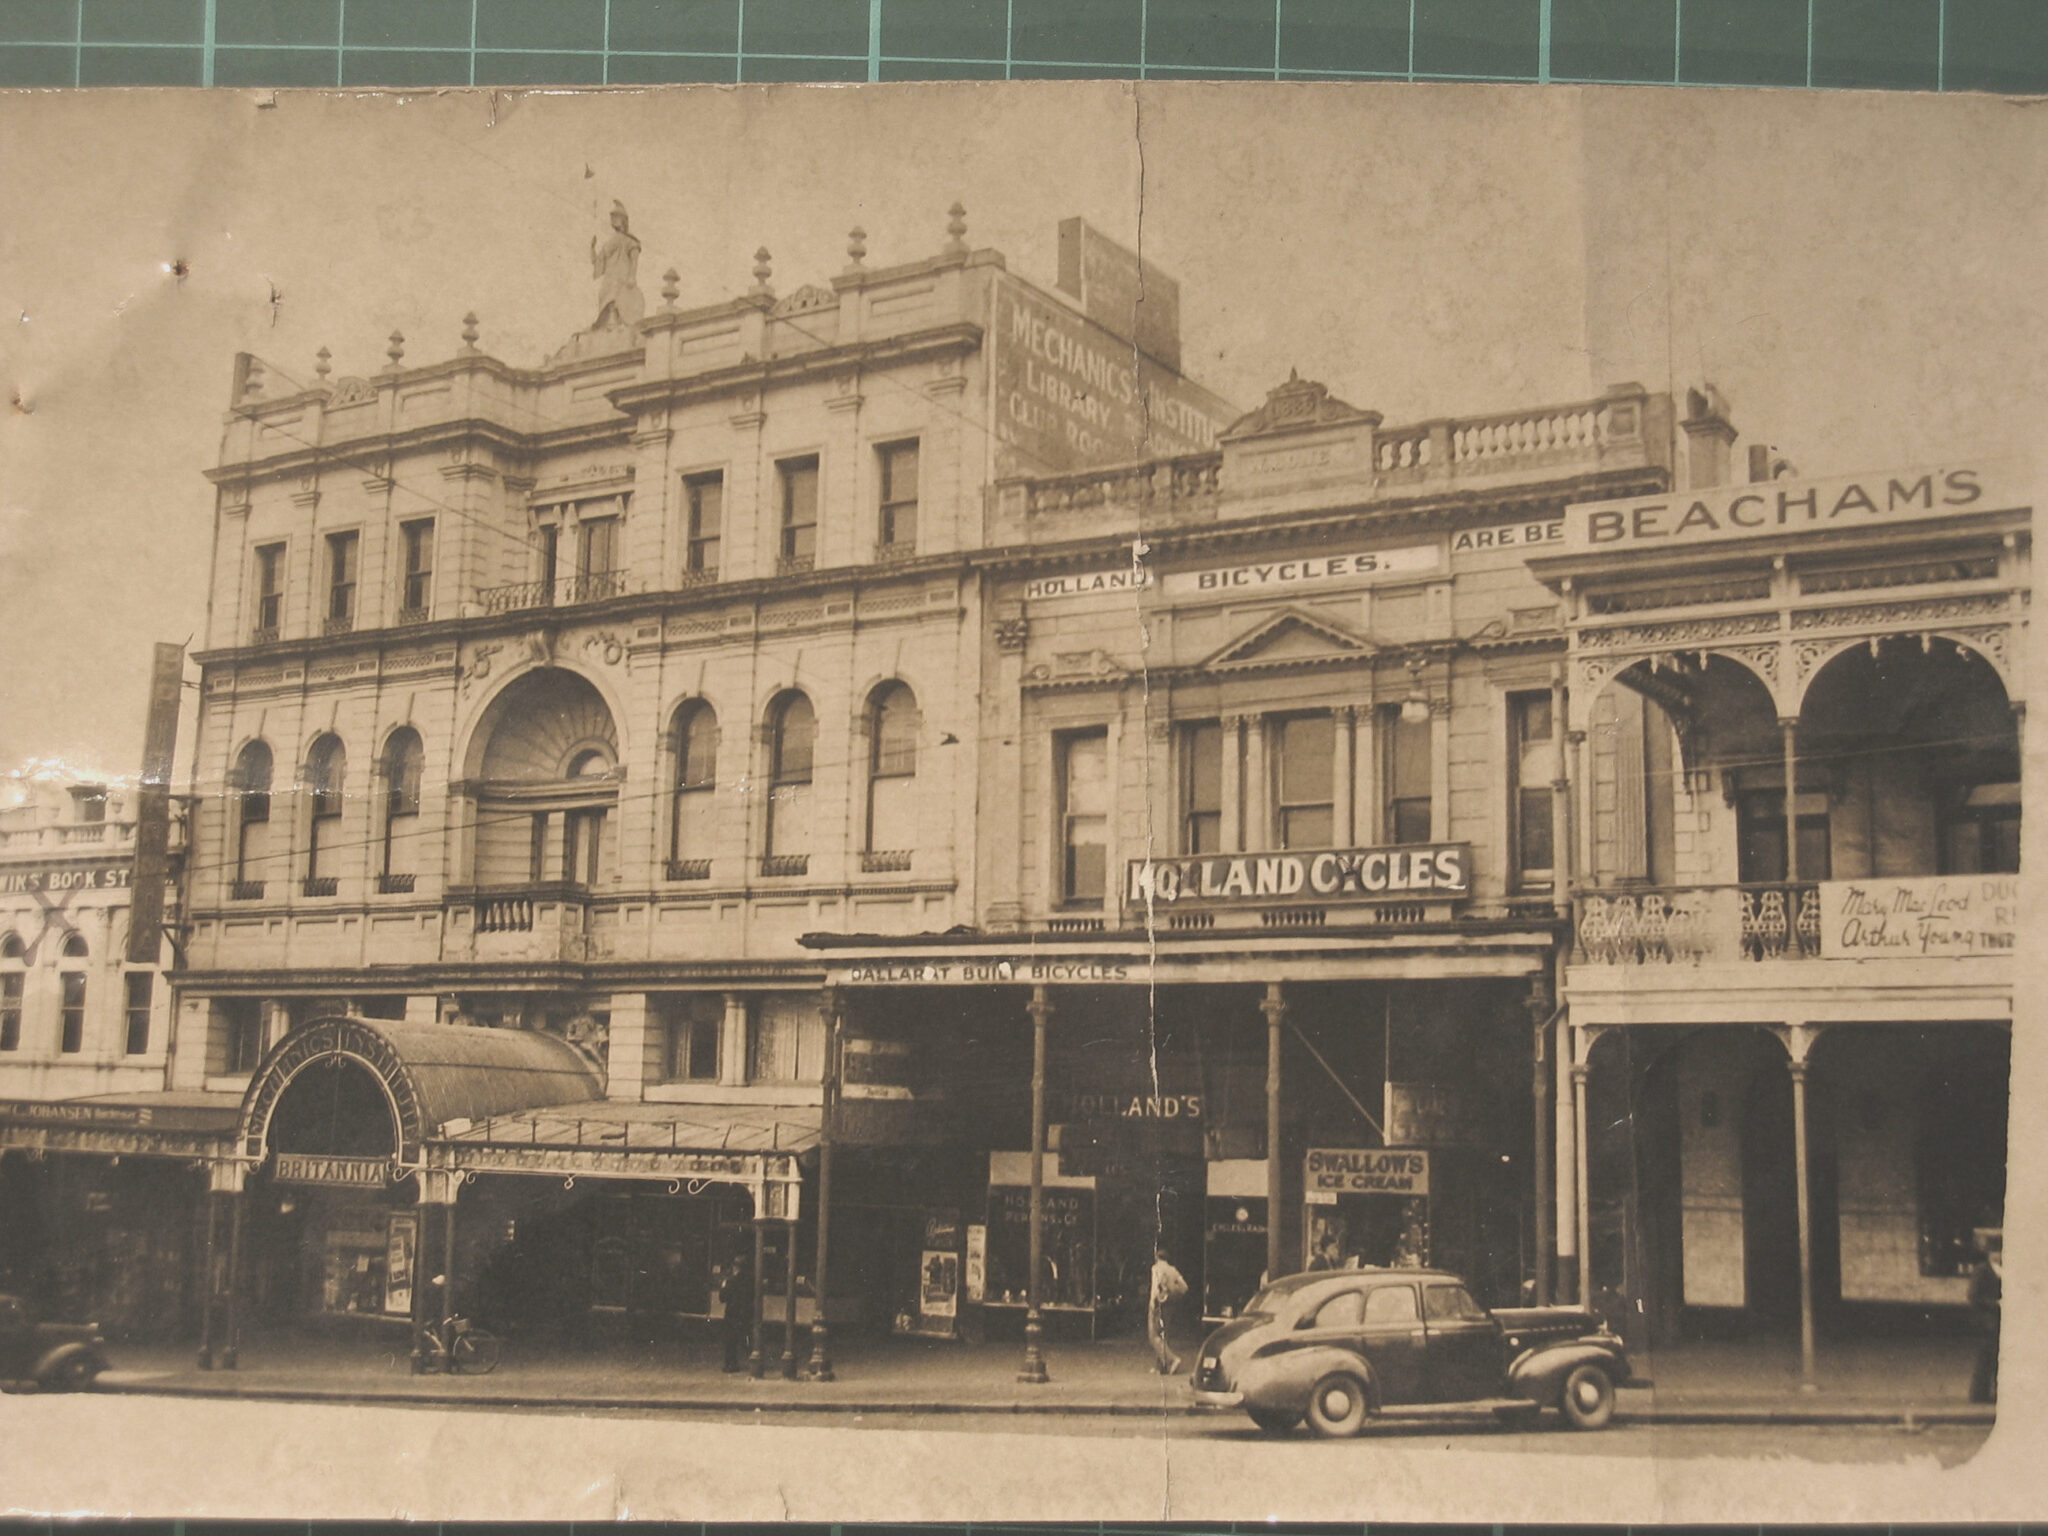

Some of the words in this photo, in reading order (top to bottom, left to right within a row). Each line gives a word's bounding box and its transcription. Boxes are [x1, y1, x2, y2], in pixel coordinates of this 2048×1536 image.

[1027, 360, 1111, 429] LIBRARY
[1587, 469, 1982, 543] BEACHAM'S
[1198, 554, 1391, 590] BICYCLES.
[1455, 528, 1515, 551] ARE
[48, 871, 97, 891] BOOK
[1130, 855, 1305, 902] HOLLAND
[1310, 850, 1464, 894] CYCLES
[1840, 885, 1888, 917] Mary
[1841, 917, 1911, 948] Arthur
[1917, 921, 1974, 953] Young
[962, 965, 1020, 982] BUILT
[1031, 964, 1128, 982] BICYCLES
[278, 1159, 382, 1183] BRITANNIA
[1308, 1151, 1425, 1175] SWALLOW'S
[1317, 1174, 1344, 1189] ICE
[1351, 1174, 1414, 1190] CREAM
